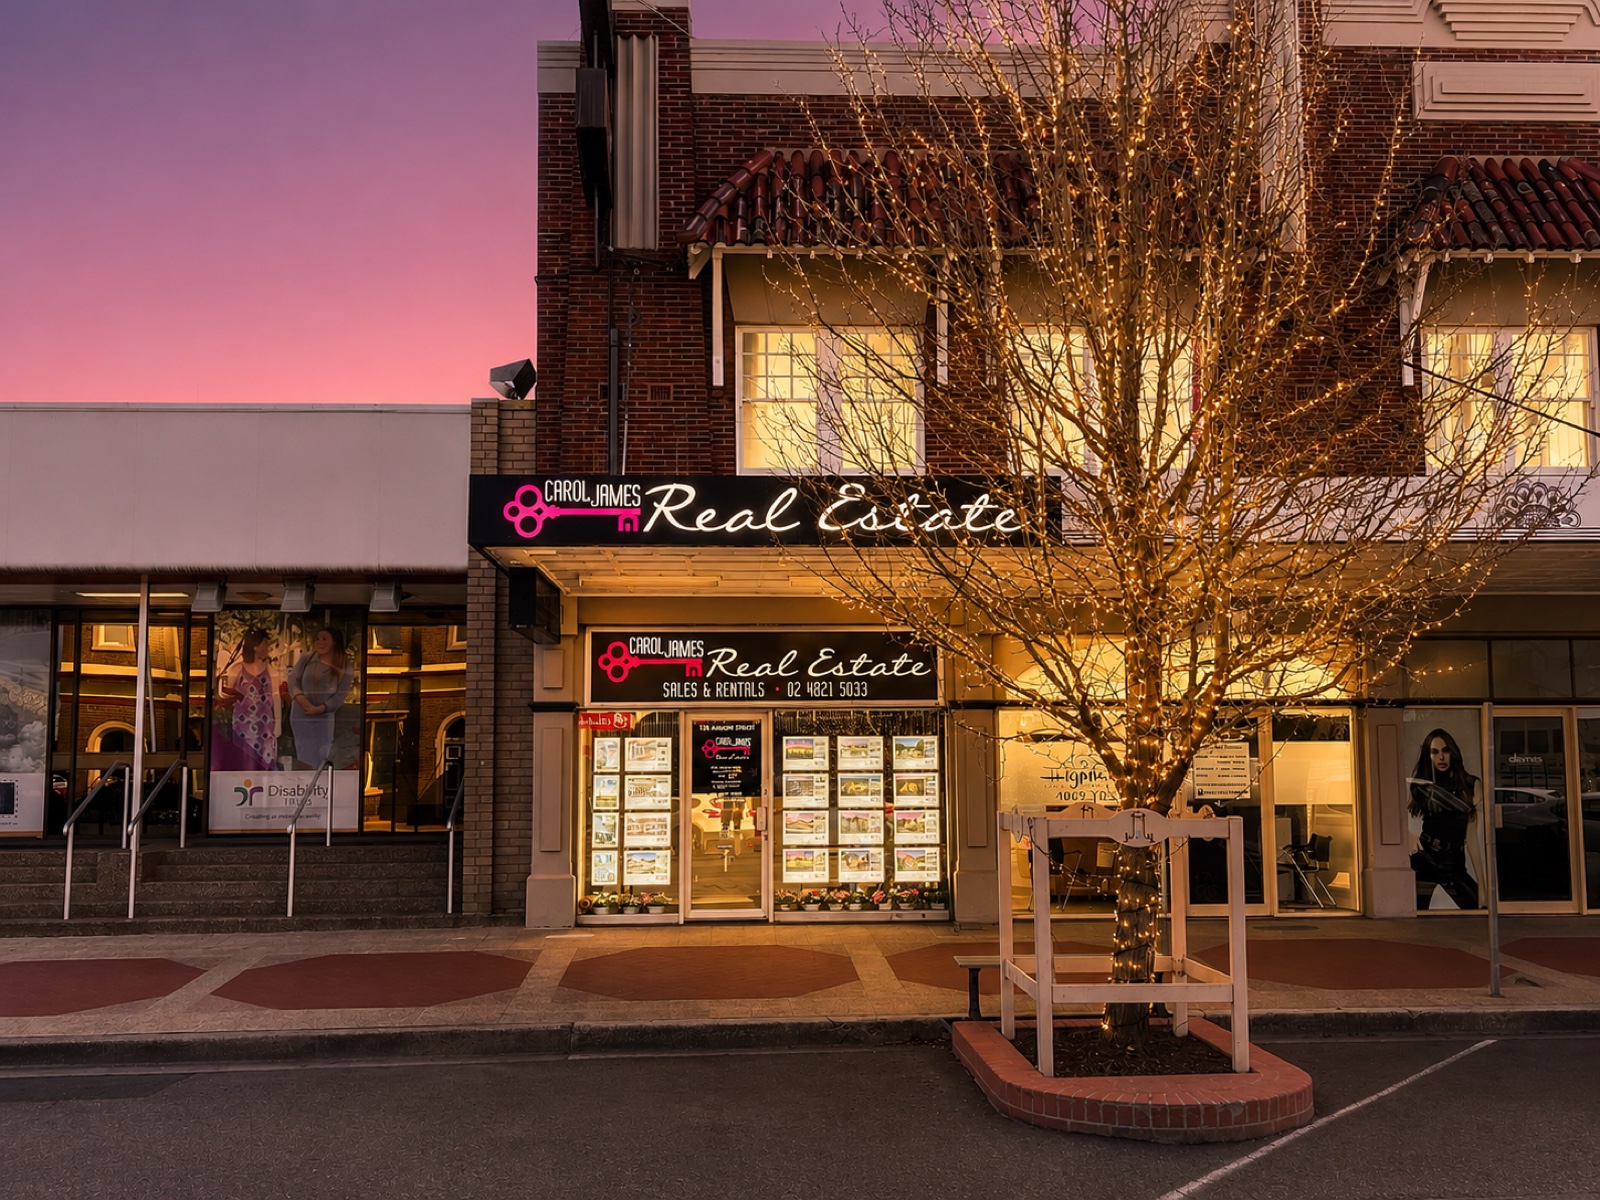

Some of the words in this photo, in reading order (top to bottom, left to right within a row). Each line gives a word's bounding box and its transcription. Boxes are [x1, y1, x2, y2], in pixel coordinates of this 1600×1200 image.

[544, 479, 591, 503] CAROL
[590, 484, 641, 508] JAMES
[643, 483, 801, 533] Real
[818, 483, 1031, 532] Estate
[629, 636, 665, 655] CAROL
[663, 640, 704, 658] JAMES
[706, 647, 799, 678] Real
[807, 647, 931, 677] Estate
[663, 682, 698, 698] SALES
[703, 682, 712, 698] &
[715, 682, 765, 698] RENTALS
[787, 681, 801, 698] 02
[806, 681, 834, 698] 4821
[839, 681, 868, 698] 5033
